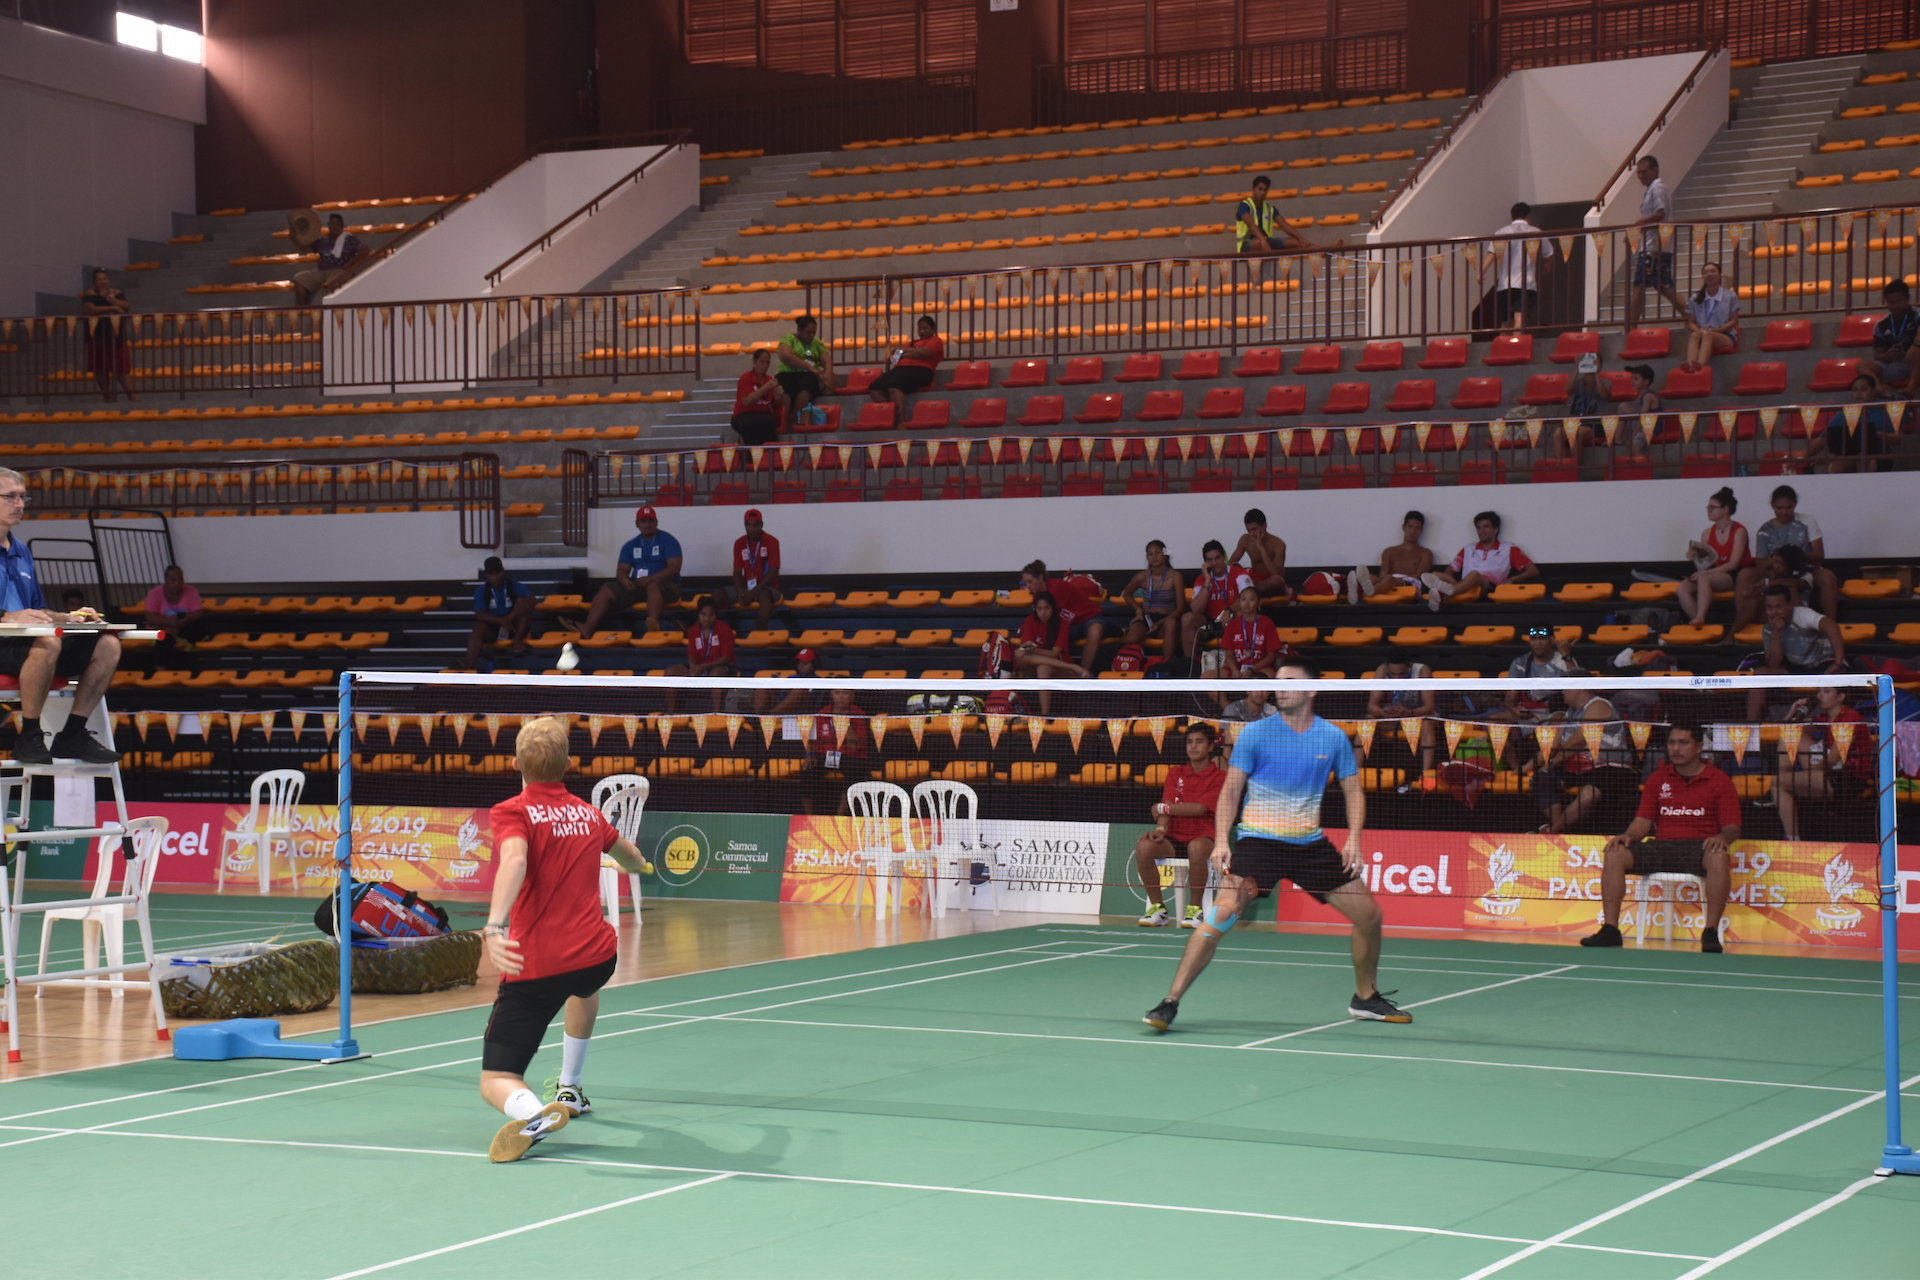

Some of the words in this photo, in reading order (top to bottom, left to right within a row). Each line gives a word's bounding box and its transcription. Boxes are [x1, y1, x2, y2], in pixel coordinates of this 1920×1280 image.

[292, 814, 363, 833] SAMA
[369, 816, 427, 838] 2019
[552, 821, 591, 837] TAHITI
[97, 821, 209, 862] Dcel
[728, 840, 758, 851] Samoa
[1012, 838, 1096, 854] SAMOA
[40, 846, 59, 855] Bank
[274, 840, 354, 859] PACIFI
[361, 842, 432, 861] GAMES
[667, 849, 696, 862] SCB
[715, 851, 769, 862] Commercial
[1010, 853, 1096, 867] SHIPPING
[1732, 852, 1772, 878] 19
[304, 865, 394, 882] #SAMA2019
[728, 863, 752, 874] Bank
[1008, 865, 1095, 881] CORPORATION
[1352, 851, 1452, 894] icel
[1006, 881, 1093, 894] LIMITED
[1548, 876, 1664, 902] PACIC
[1675, 881, 1786, 908] GMES
